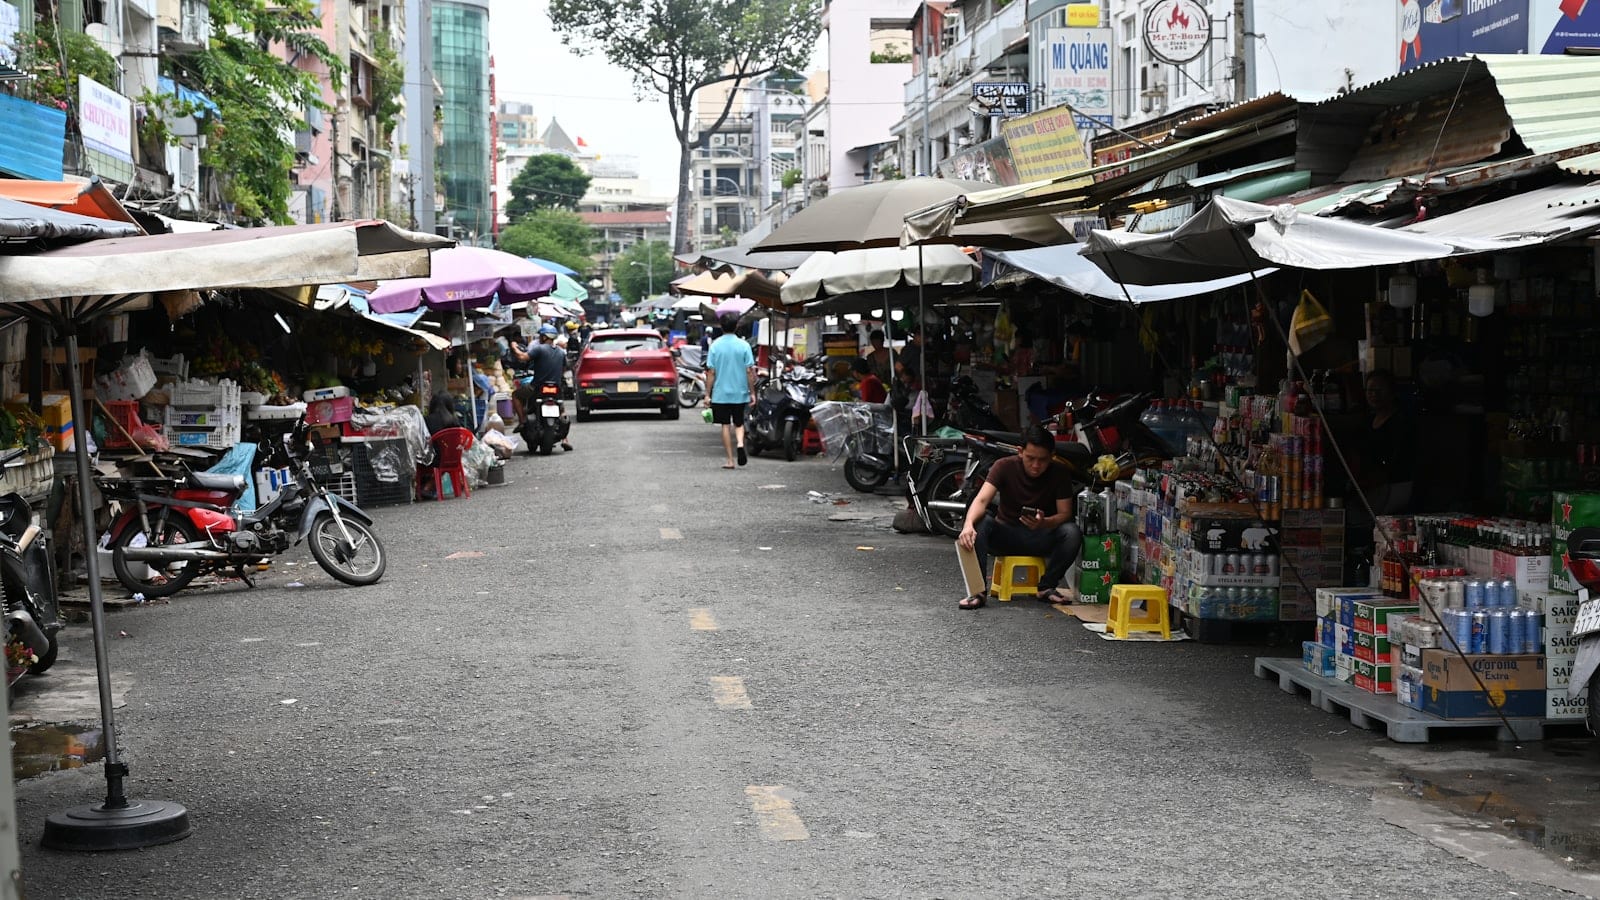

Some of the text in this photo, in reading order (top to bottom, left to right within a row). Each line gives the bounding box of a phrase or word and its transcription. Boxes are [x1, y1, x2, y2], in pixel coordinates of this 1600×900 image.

[1052, 32, 1108, 73] MÌ QUẢNG
[1054, 76, 1107, 88] ANH EM
[977, 86, 1026, 96] CENTANA
[1551, 606, 1577, 617] SAIG
[1551, 636, 1582, 647] SAIG
[1473, 657, 1520, 673] Corona
[1485, 670, 1510, 680] Extra
[1551, 696, 1587, 707] SAIGO
